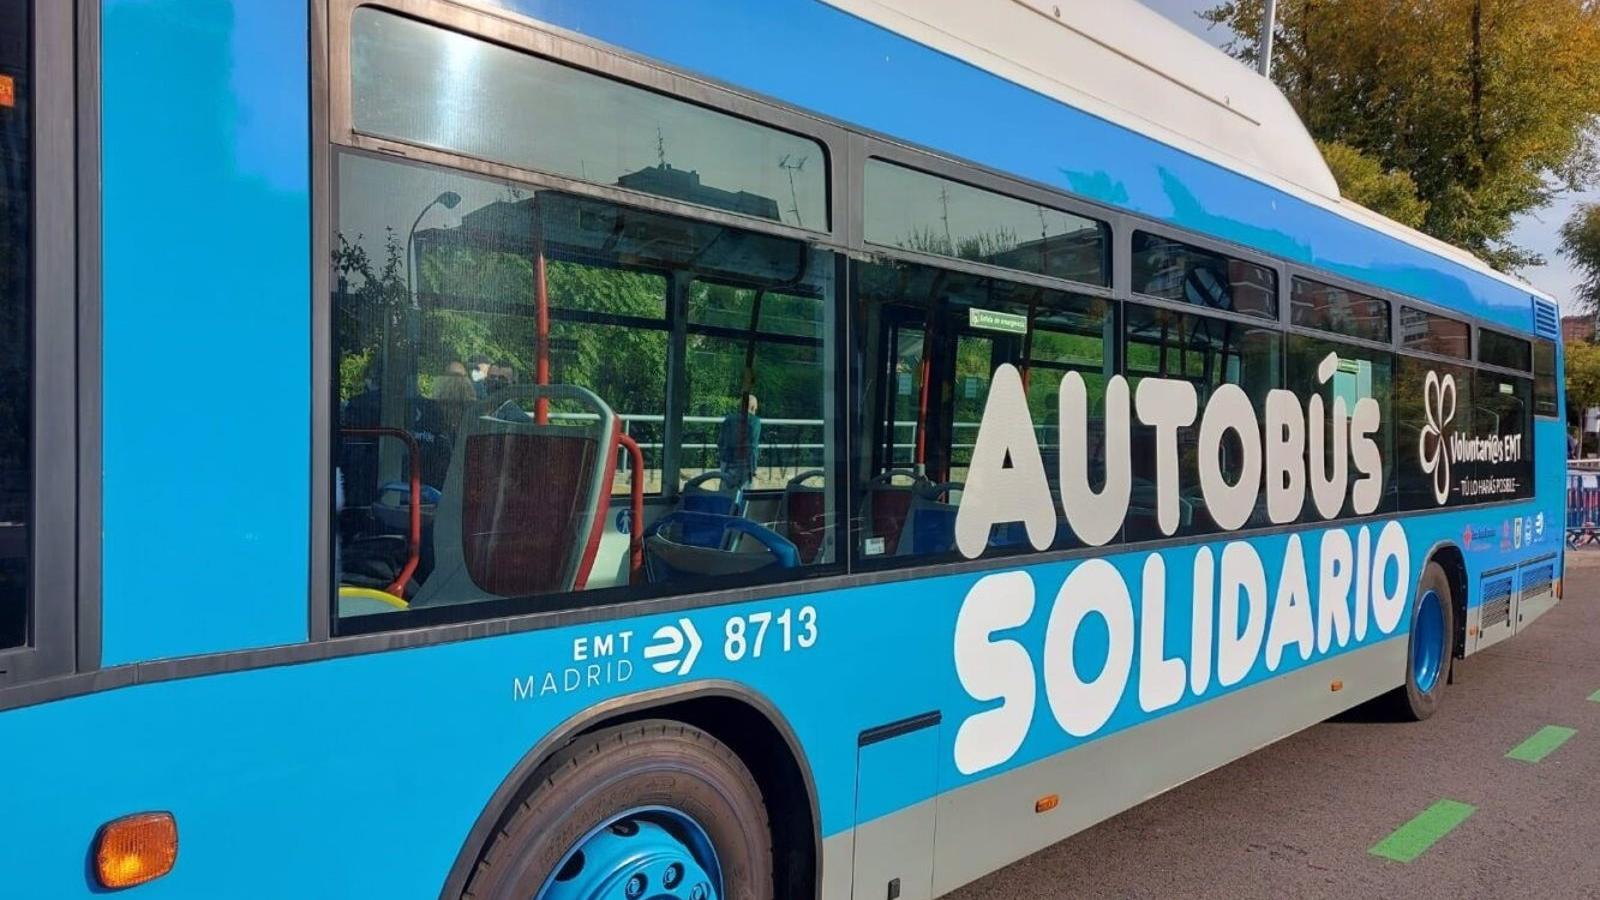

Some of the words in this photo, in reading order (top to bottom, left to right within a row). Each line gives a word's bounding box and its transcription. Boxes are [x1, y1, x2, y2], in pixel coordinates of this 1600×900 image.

[954, 352, 1383, 559] AUTOBÚS
[1450, 431, 1503, 464] Voluntari@s
[1504, 433, 1521, 462] EMT
[1461, 475, 1470, 496] TÚ
[1470, 480, 1478, 495] LO
[1478, 475, 1496, 494] HARÁS
[1496, 478, 1515, 493] POSIBLE
[573, 631, 633, 661] EMT
[723, 605, 818, 661] 8713
[953, 520, 1410, 775] SOLIDARIO
[513, 659, 634, 701] MADRID
